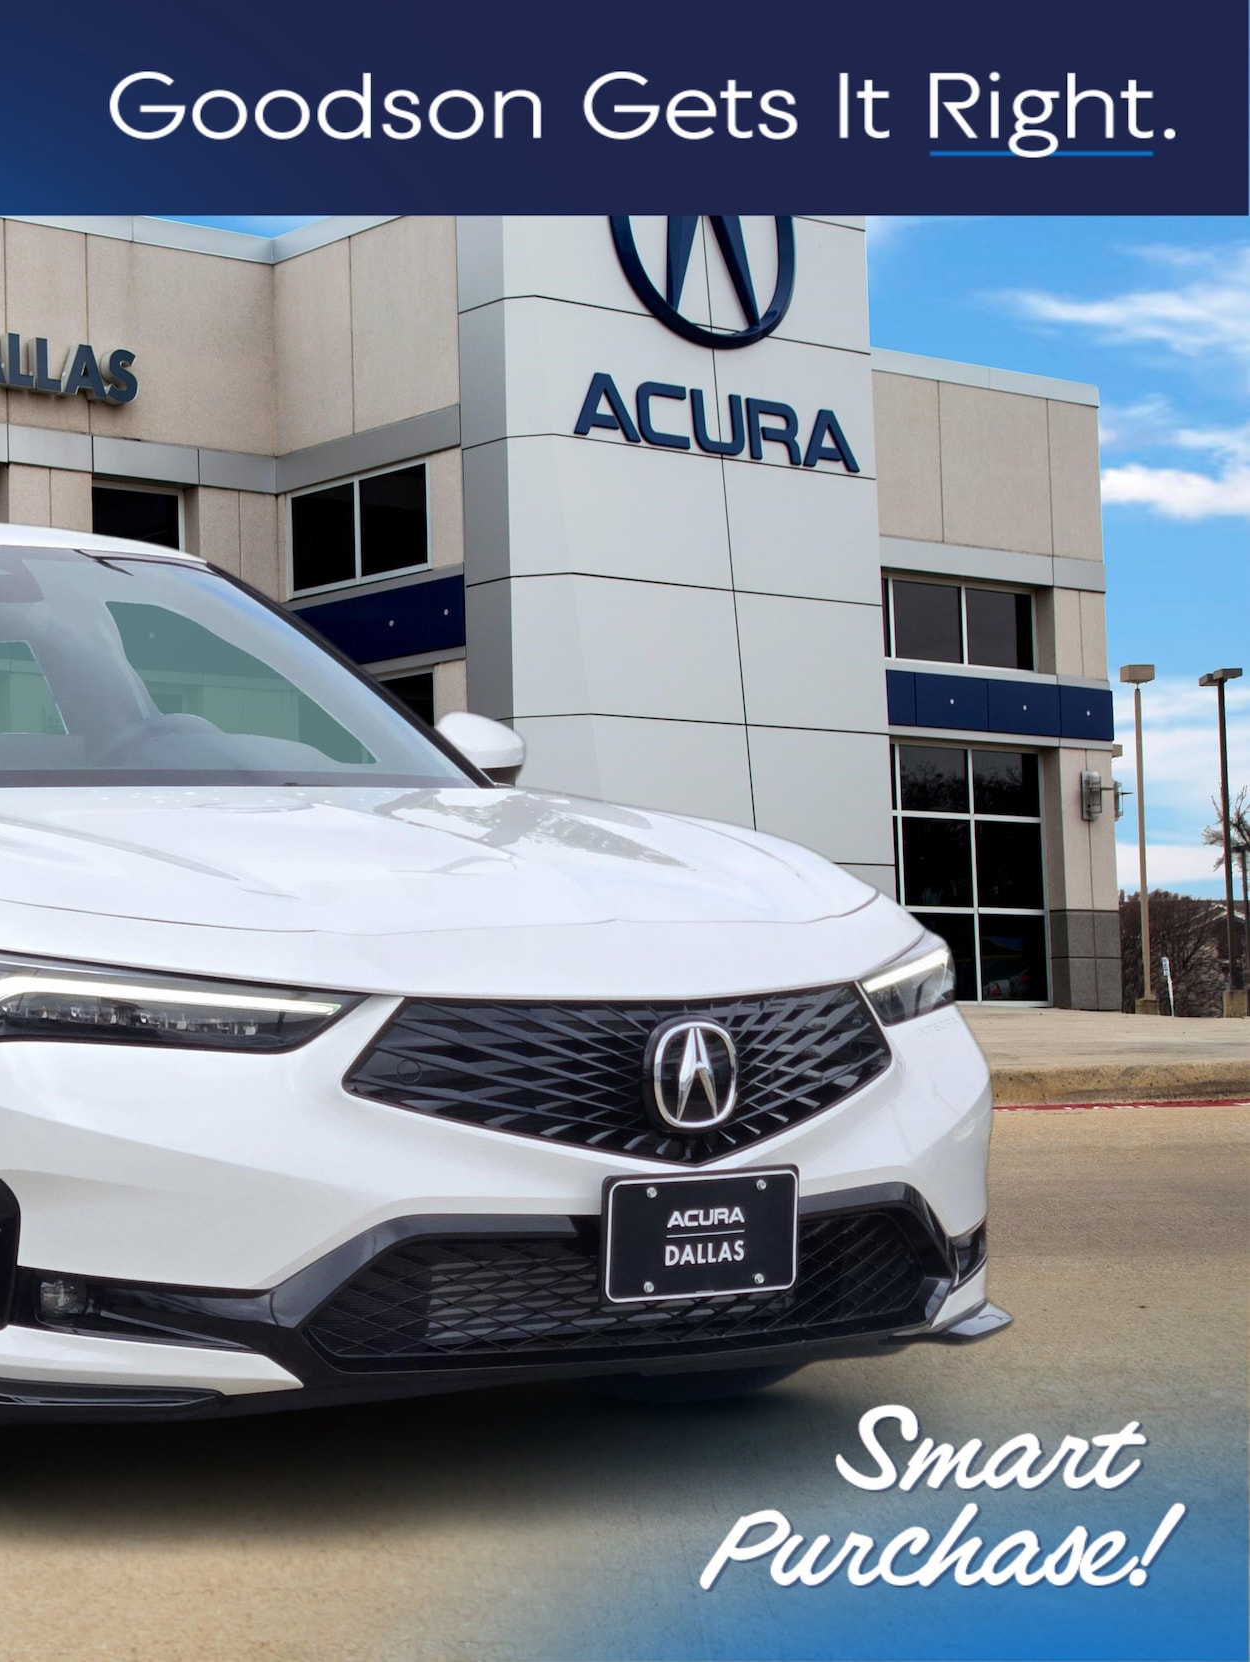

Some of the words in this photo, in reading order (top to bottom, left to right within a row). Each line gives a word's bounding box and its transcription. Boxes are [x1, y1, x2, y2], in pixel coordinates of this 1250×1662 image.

[573, 372, 860, 473] ACURA
[666, 1206, 746, 1229] ACURA
[664, 1240, 746, 1267] DALLAS
